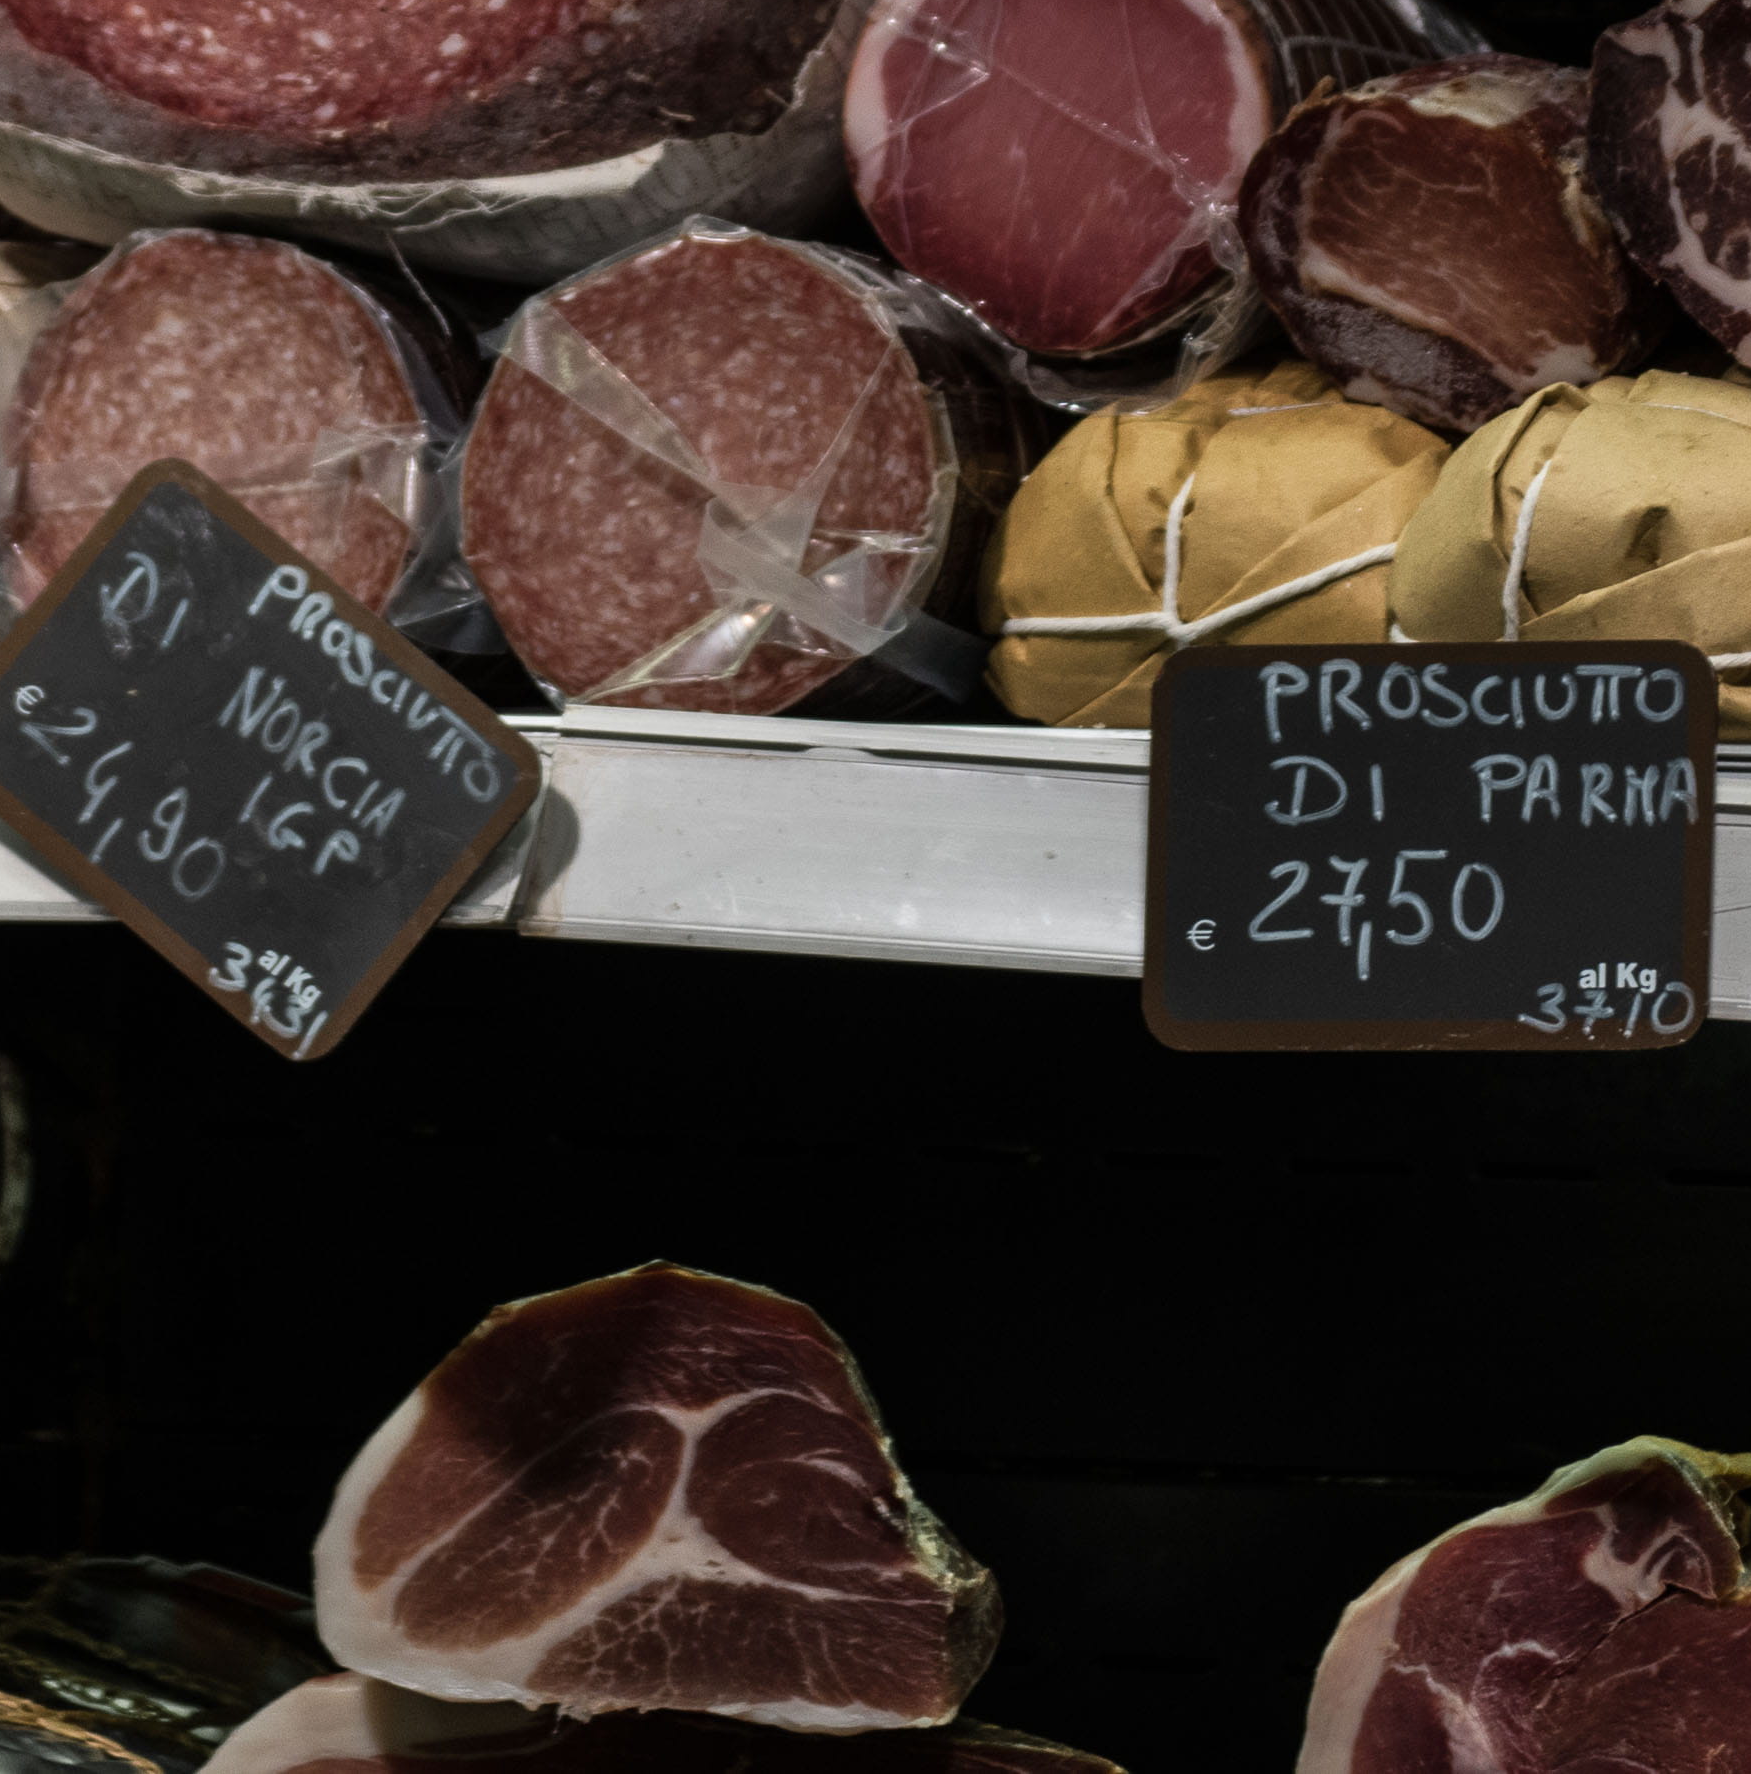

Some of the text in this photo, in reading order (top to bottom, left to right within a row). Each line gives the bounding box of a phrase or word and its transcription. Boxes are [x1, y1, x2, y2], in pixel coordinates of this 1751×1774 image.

[13, 684, 45, 715] €
[249, 565, 500, 802] PROSCIUTTO
[1258, 658, 1687, 743] PROSCIUTTO
[218, 666, 407, 837] NORCIA
[1263, 752, 1699, 826] DI PARMA
[240, 773, 360, 875] IGP
[1186, 849, 1506, 981] € 27,50
[257, 948, 323, 1009] al Kg
[1518, 981, 1697, 1039] 3710
[1579, 962, 1659, 994] al Kg
